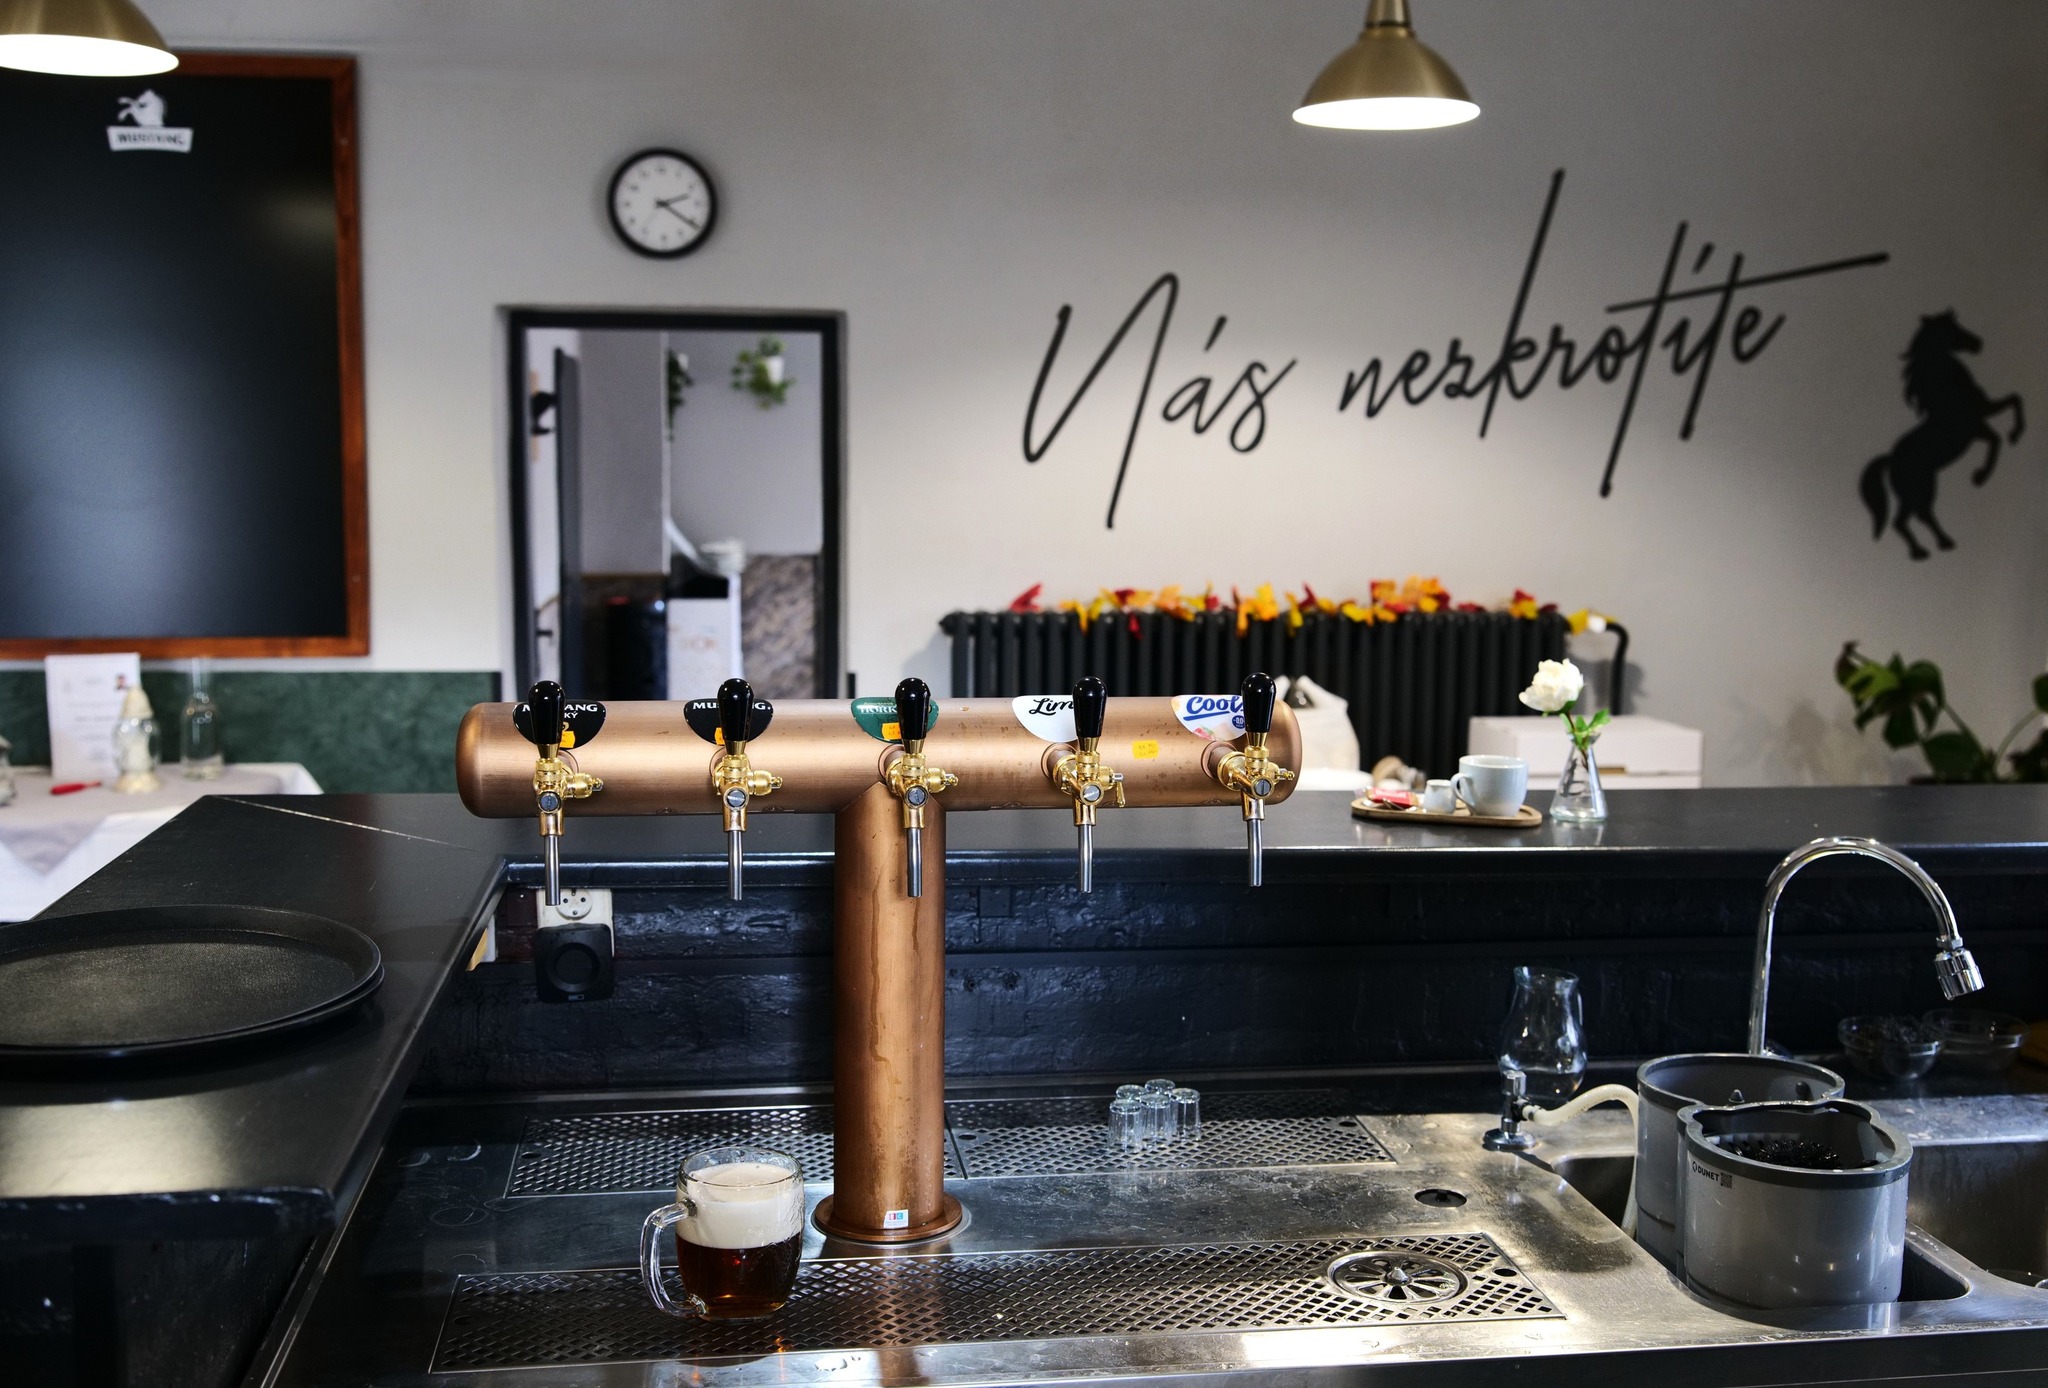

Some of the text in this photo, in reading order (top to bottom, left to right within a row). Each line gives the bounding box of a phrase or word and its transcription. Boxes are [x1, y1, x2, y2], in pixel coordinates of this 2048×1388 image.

[1022, 272, 1297, 529] Nás
[522, 704, 598, 712] MANG
[1028, 697, 1074, 716] Lim
